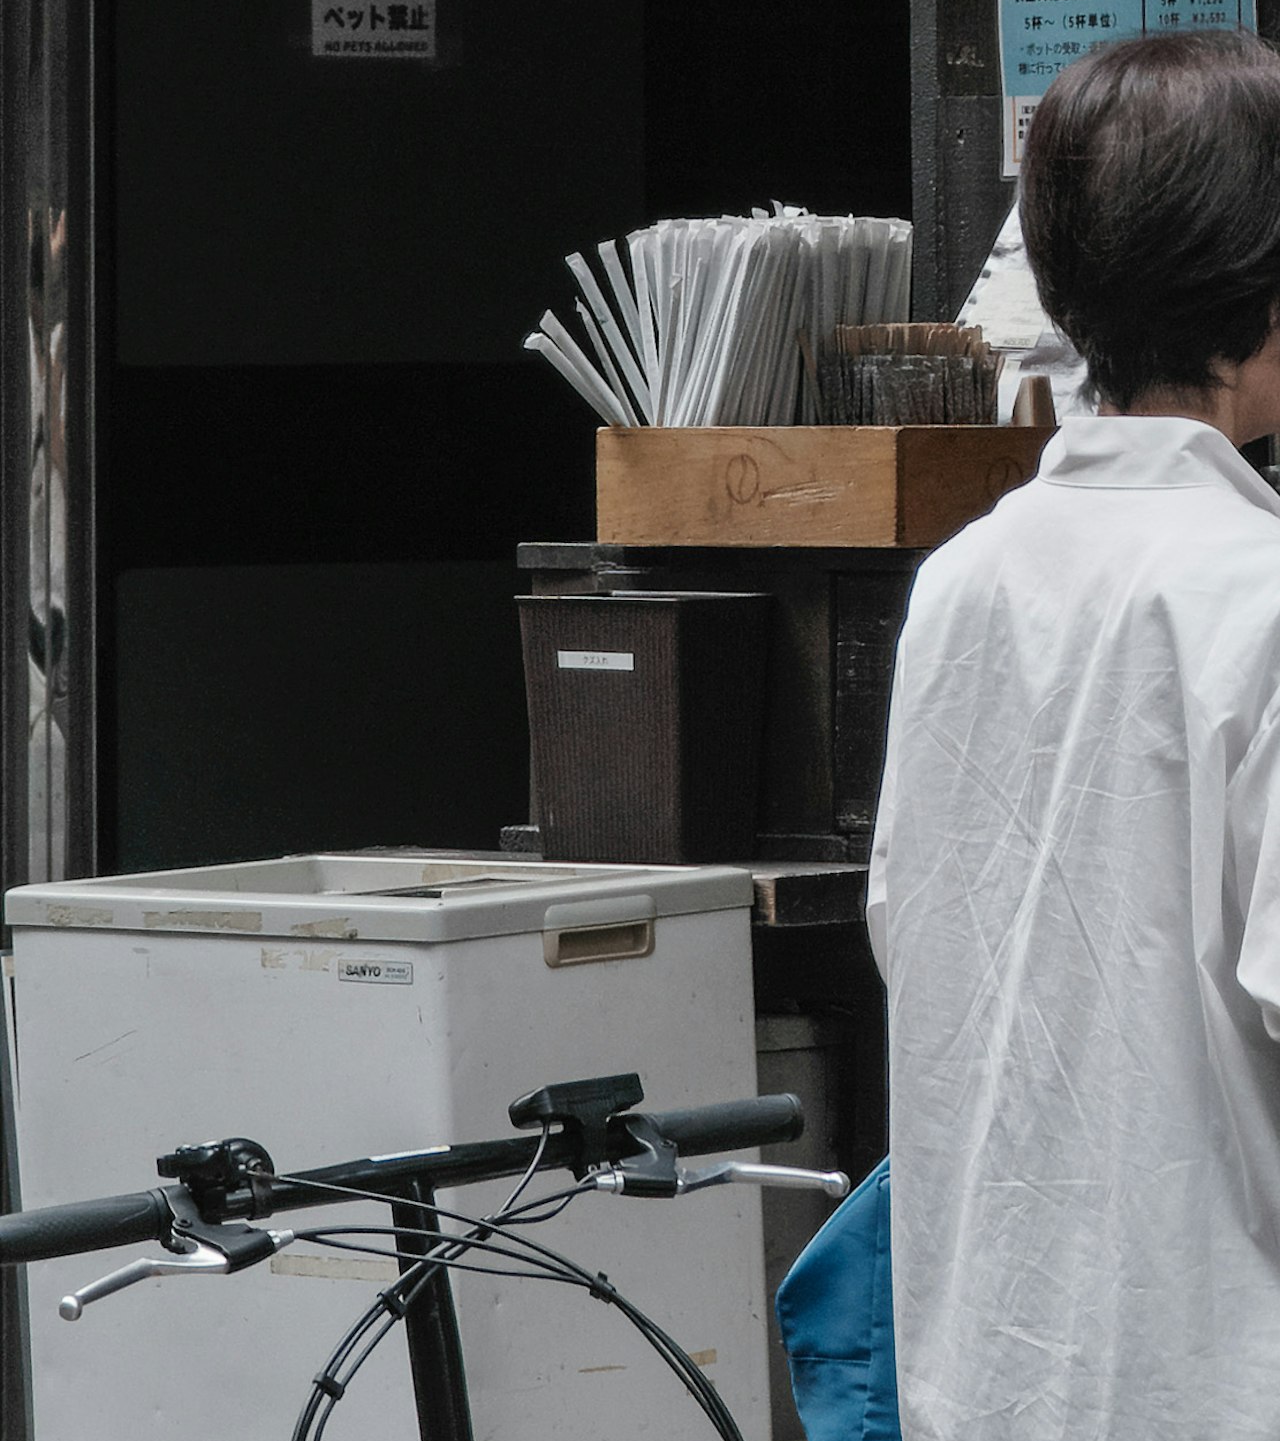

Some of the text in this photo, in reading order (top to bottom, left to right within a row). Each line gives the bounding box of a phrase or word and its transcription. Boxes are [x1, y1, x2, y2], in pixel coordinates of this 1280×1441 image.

[324, 3, 430, 32] ペット禁止
[346, 964, 381, 977] SANYO
